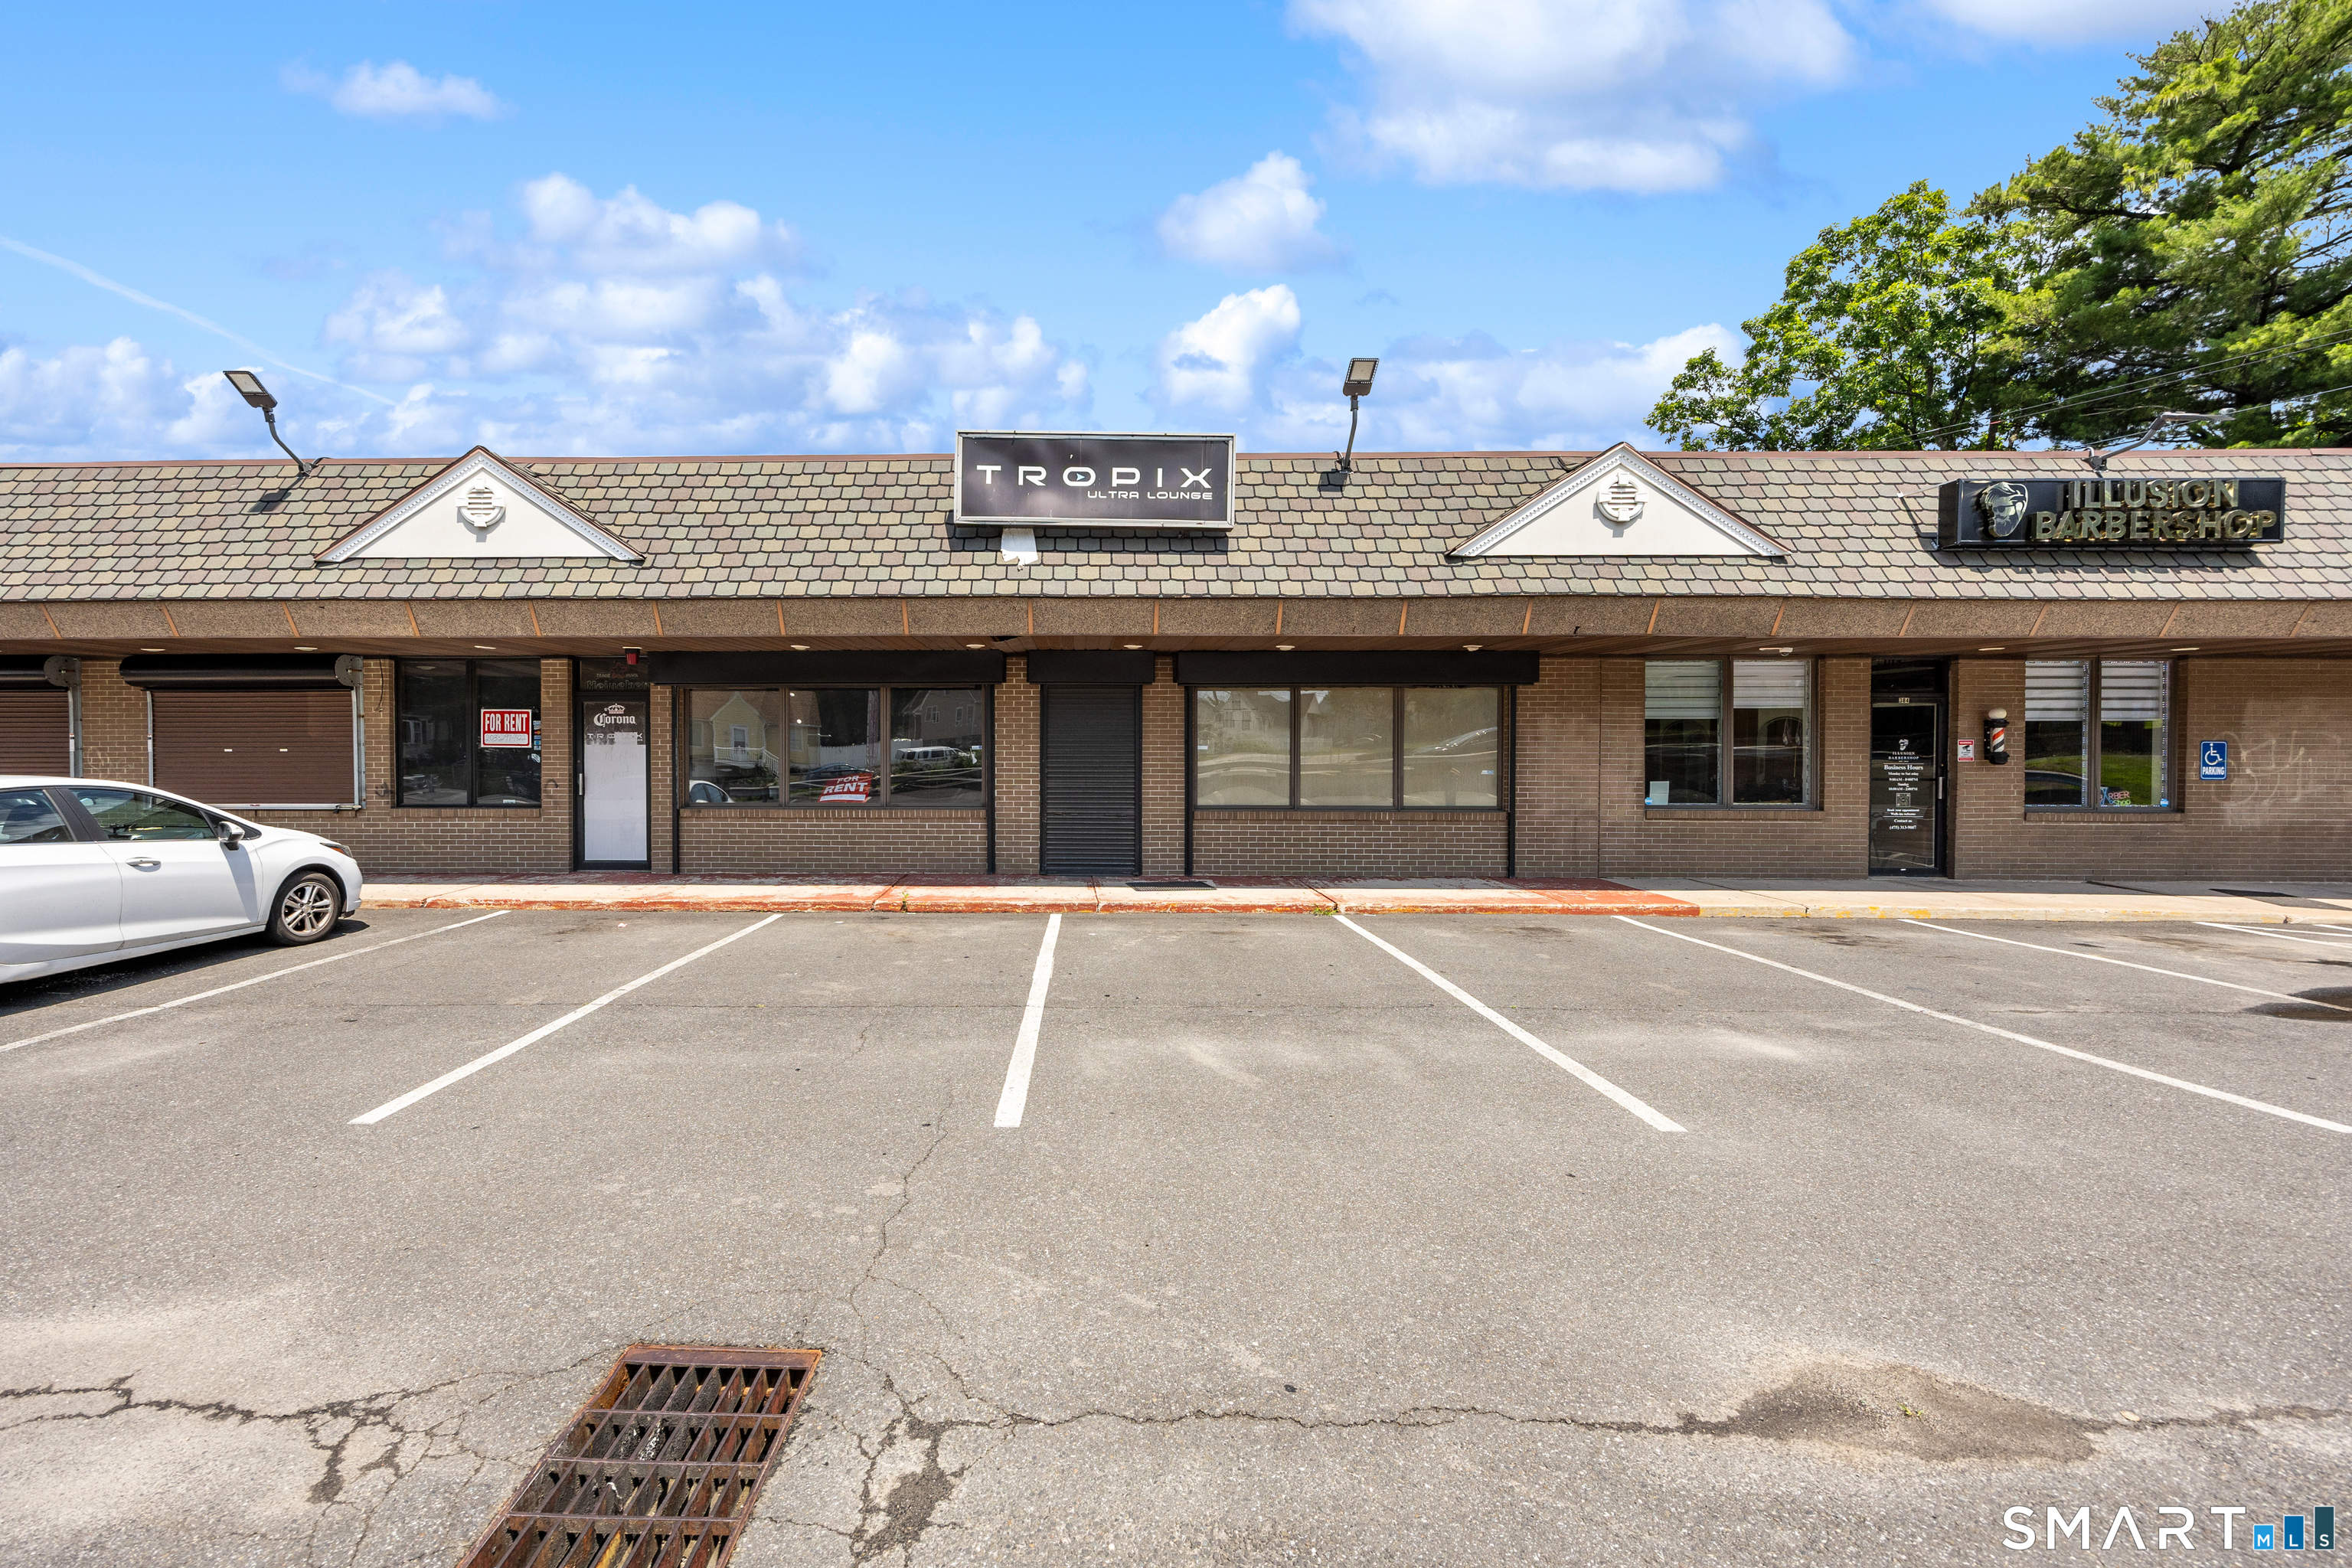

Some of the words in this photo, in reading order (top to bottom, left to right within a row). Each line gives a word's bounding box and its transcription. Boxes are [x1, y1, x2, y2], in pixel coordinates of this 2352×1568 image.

[976, 465, 1213, 489] TROPIX
[1087, 490, 1140, 499] ULTRA
[1147, 491, 1214, 501] LOUNGE
[2069, 479, 2240, 508] ILLUSION
[2034, 508, 2277, 540] BARBERSHOP
[586, 679, 651, 691] Heineken
[485, 714, 501, 731] FOR
[504, 714, 528, 731] RENT
[593, 713, 636, 728] Corona
[2202, 766, 2225, 776] PARKING
[837, 775, 860, 784] FOR
[823, 782, 868, 794] RENT
